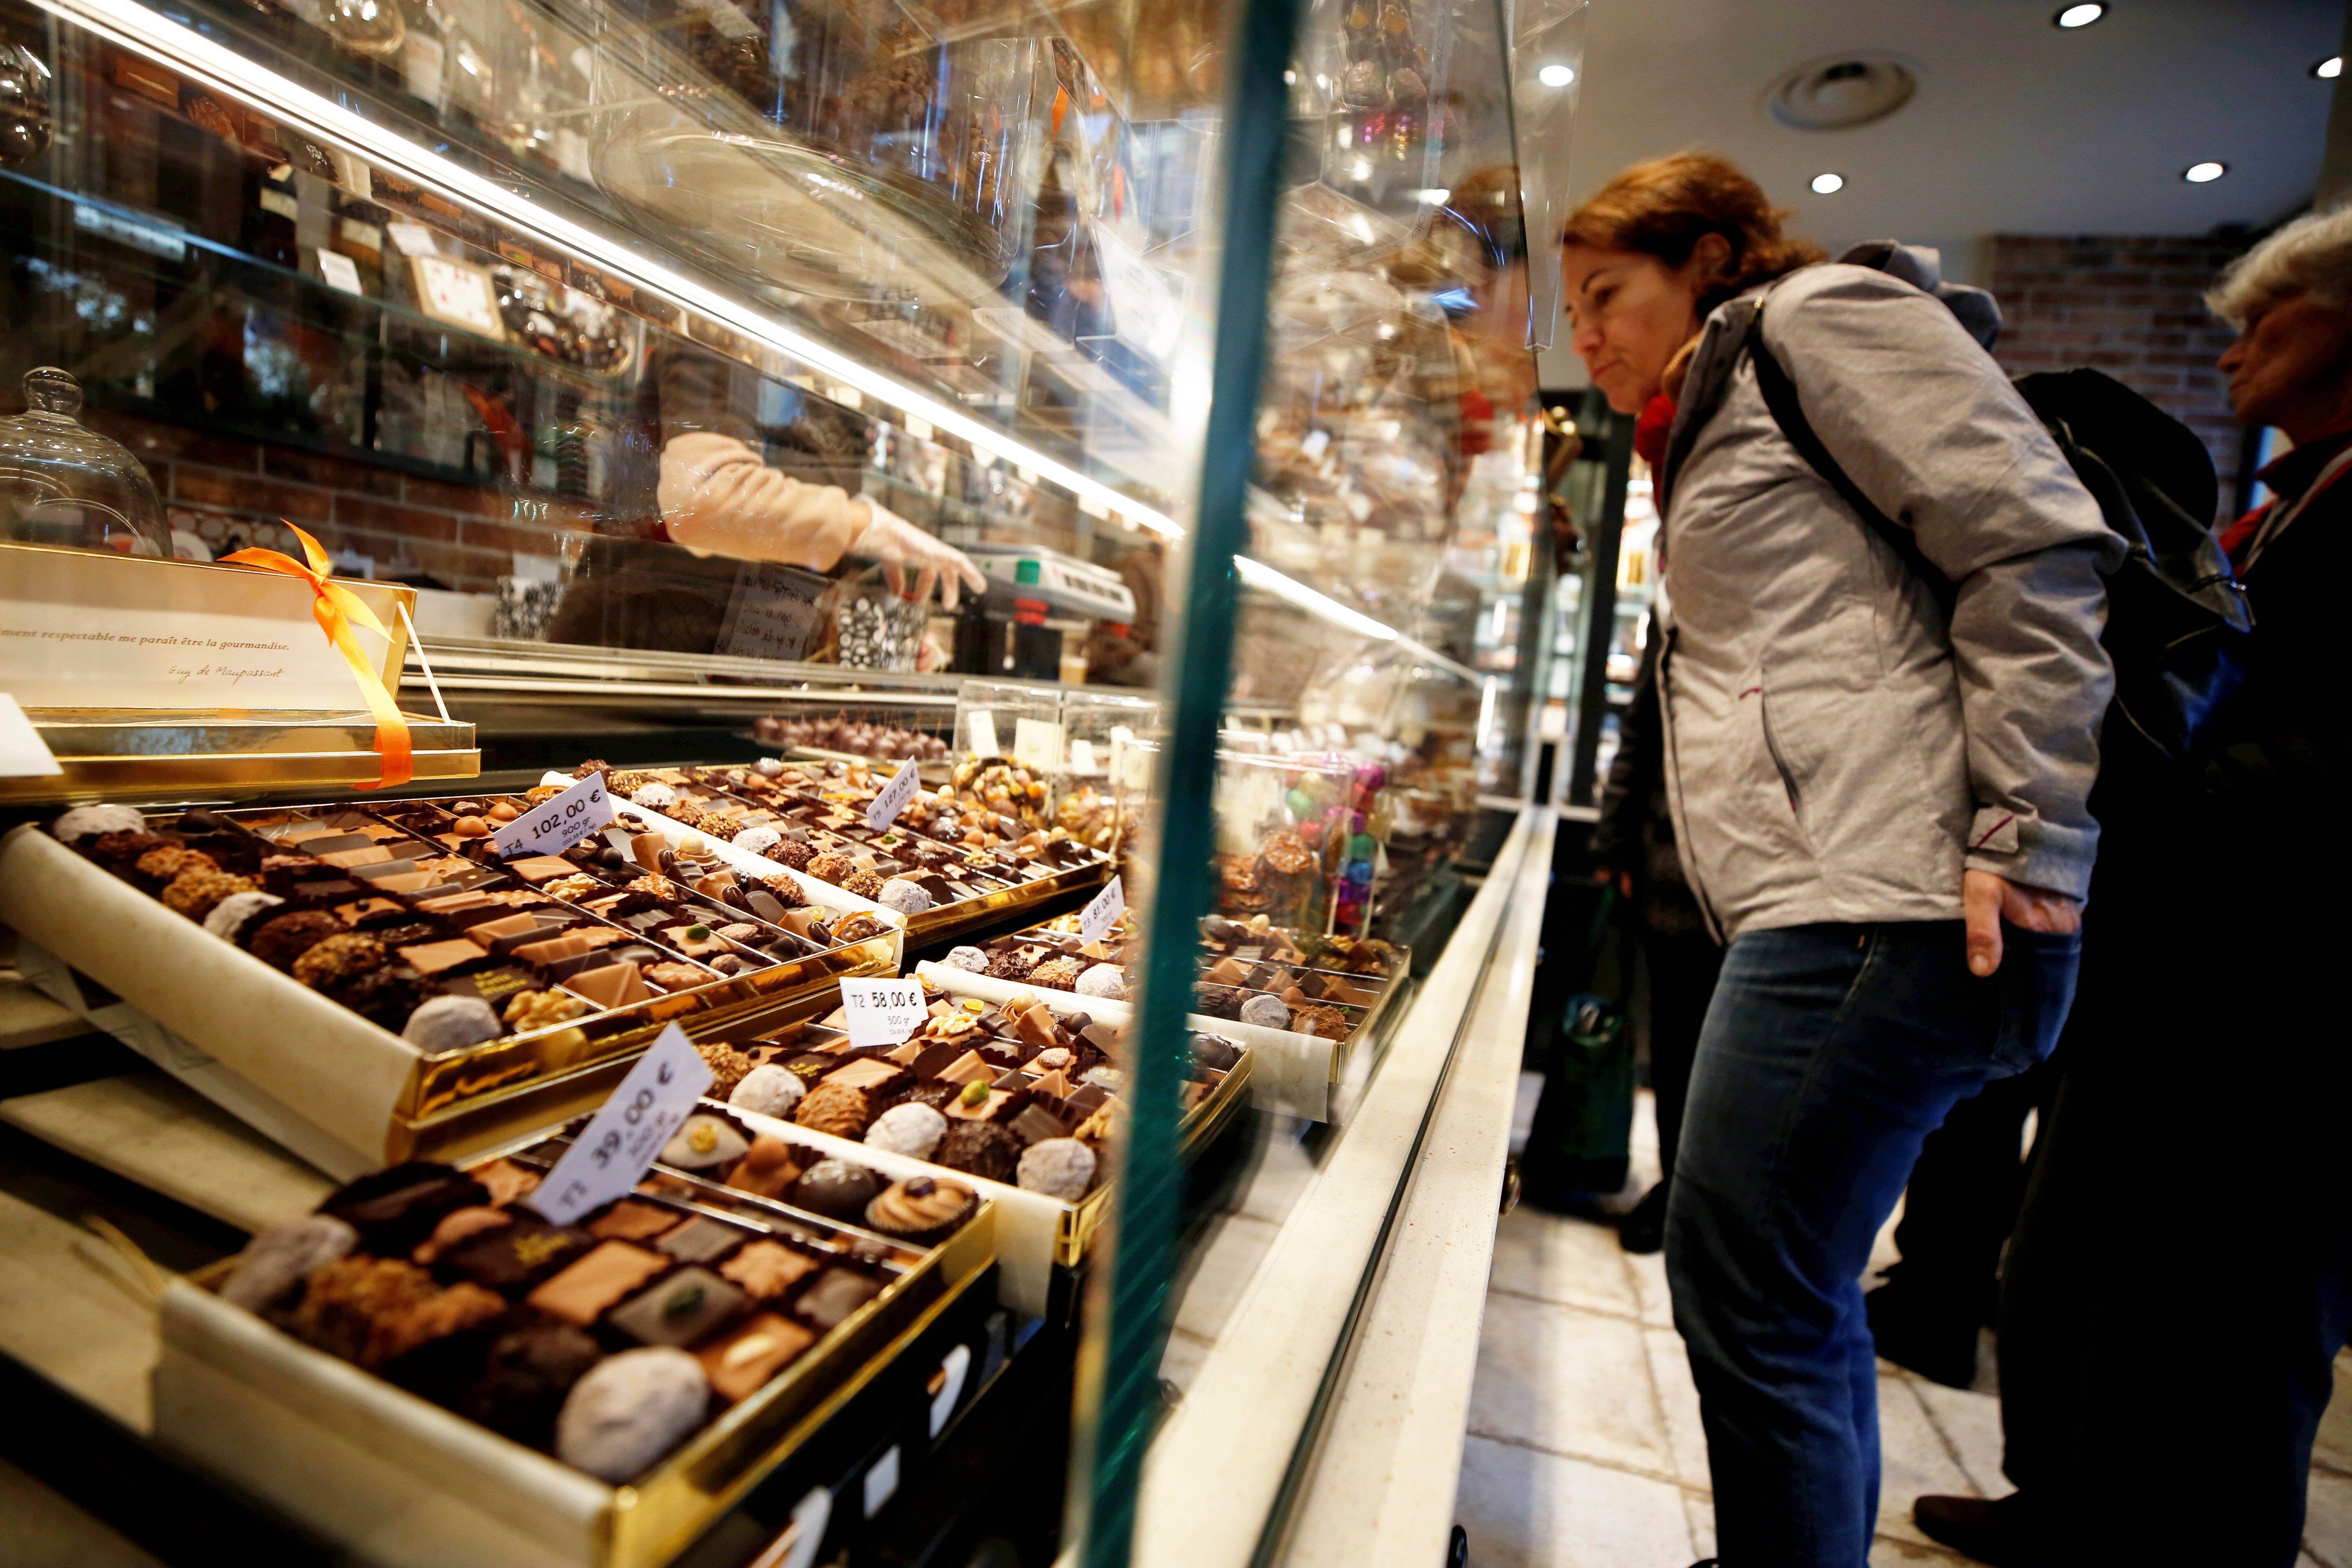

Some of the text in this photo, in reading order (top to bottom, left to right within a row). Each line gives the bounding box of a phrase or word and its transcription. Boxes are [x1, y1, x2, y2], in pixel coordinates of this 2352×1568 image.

[41, 631, 115, 642] respectable
[138, 637, 178, 646] paraît
[180, 637, 203, 646] être
[206, 639, 217, 647] la
[218, 641, 290, 650] gourmandise.
[168, 664, 285, 685] Guy de Maupassant
[503, 789, 601, 855] T4 102,00 €
[562, 817, 590, 838] 900 gr
[851, 992, 917, 1010] T2 58,00 €
[888, 1016, 910, 1027] 500 gr
